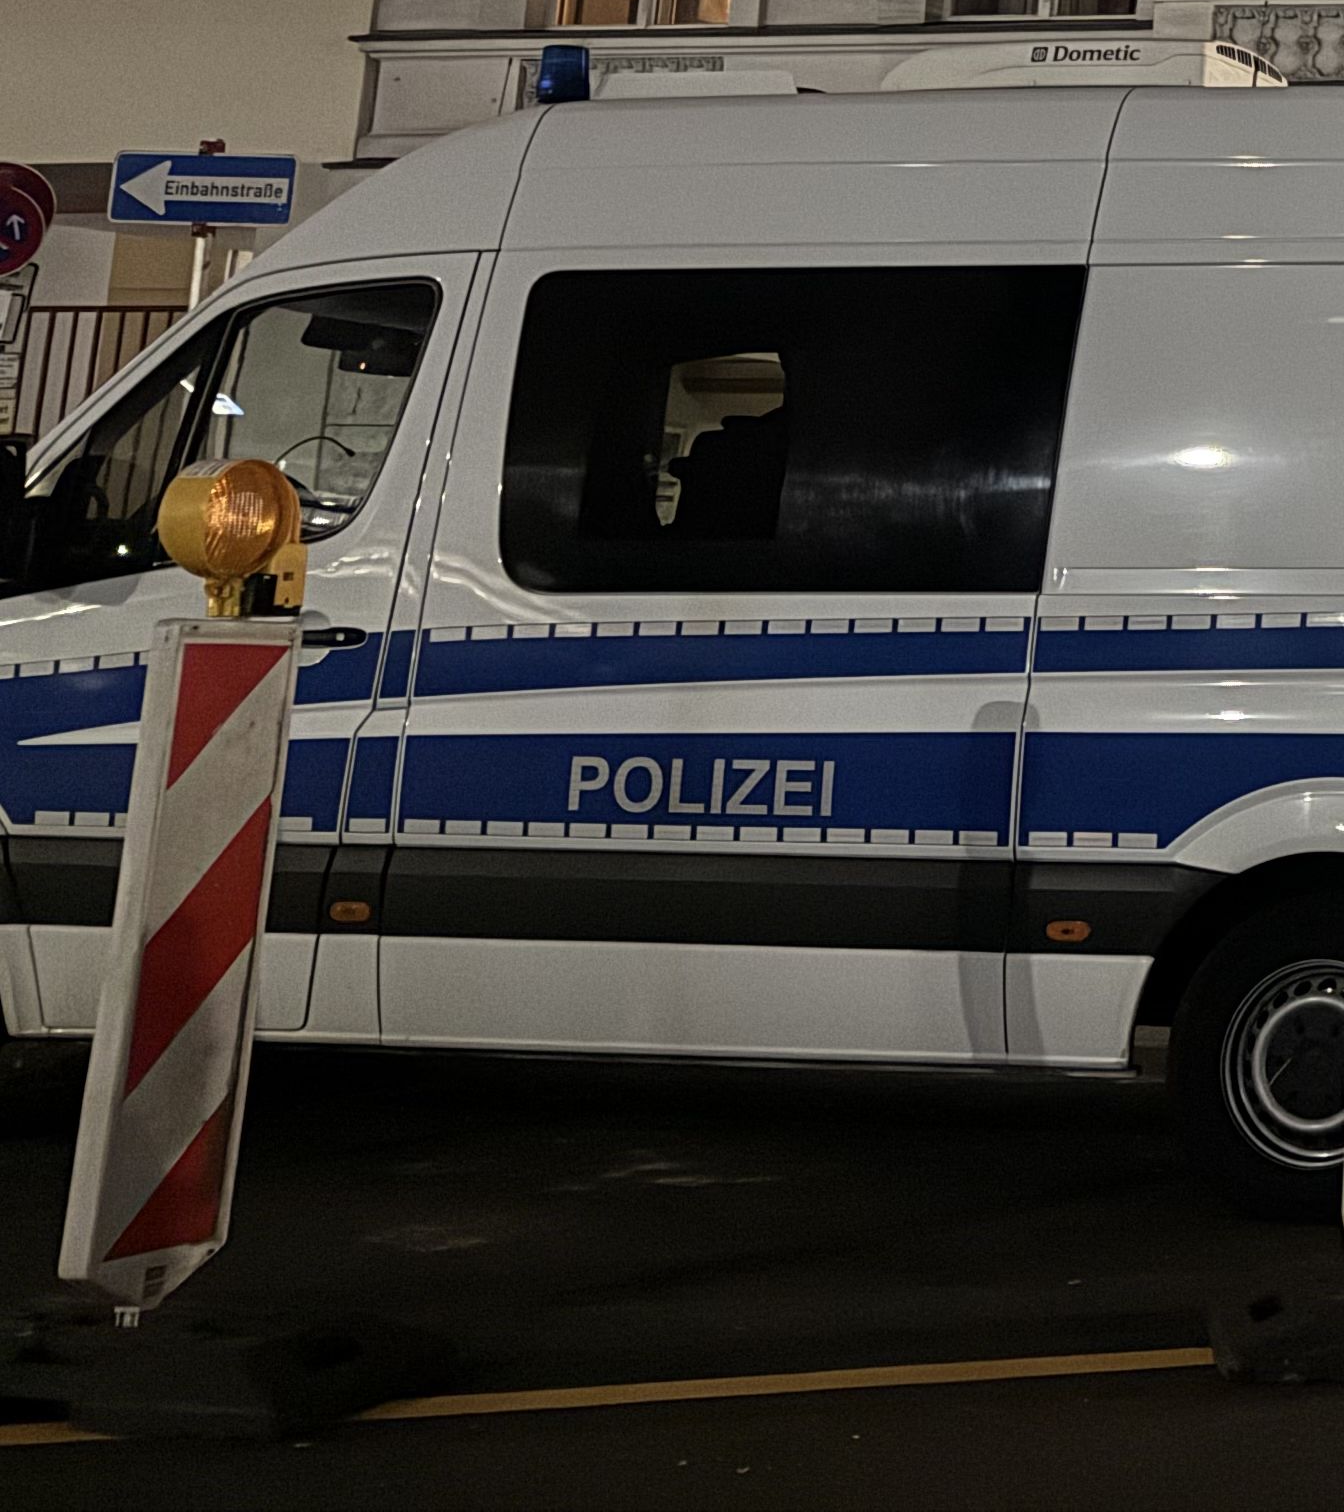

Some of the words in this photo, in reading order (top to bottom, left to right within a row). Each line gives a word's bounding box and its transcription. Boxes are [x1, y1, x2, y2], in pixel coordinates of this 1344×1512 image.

[1053, 44, 1141, 62] Dometic
[164, 180, 284, 198] Einbahnstraße
[568, 756, 835, 817] POLIZEI
